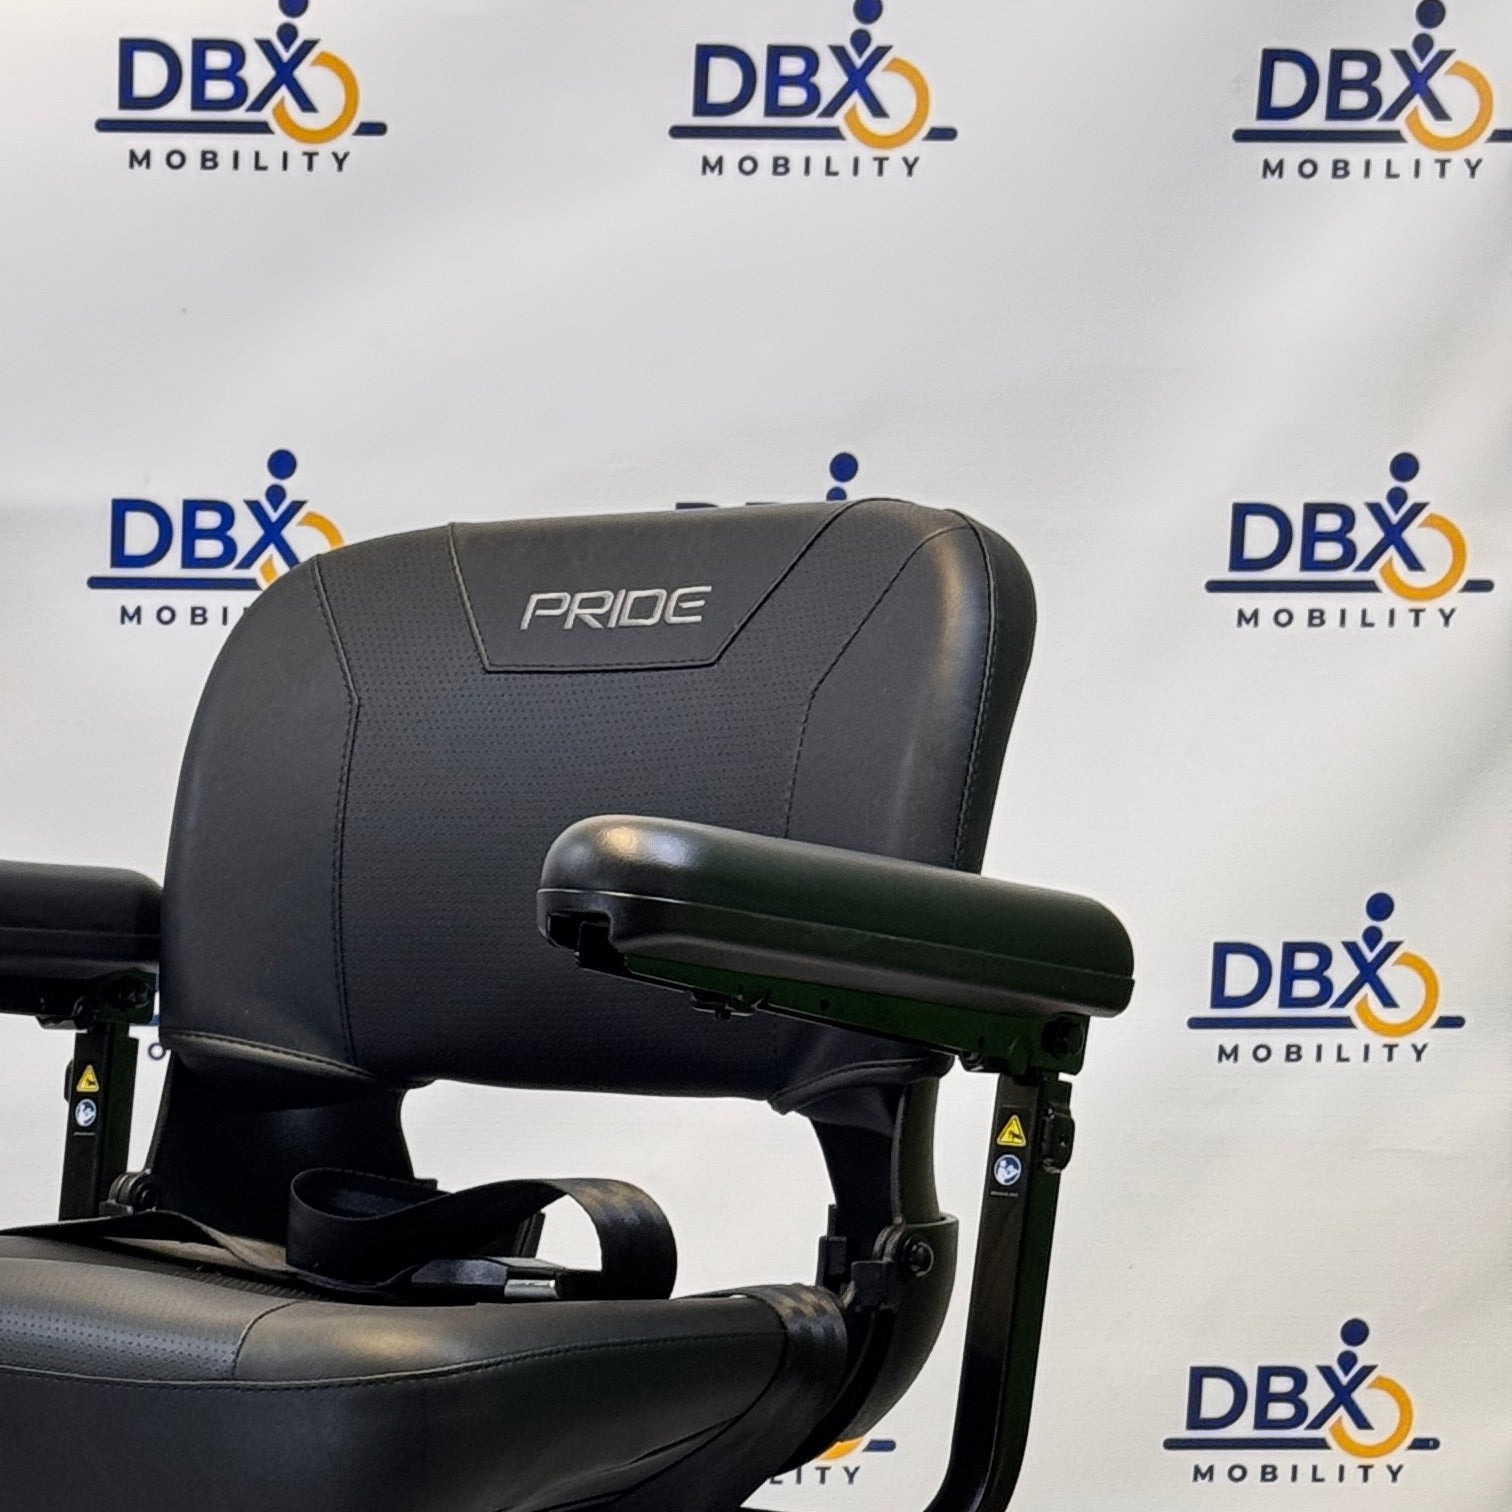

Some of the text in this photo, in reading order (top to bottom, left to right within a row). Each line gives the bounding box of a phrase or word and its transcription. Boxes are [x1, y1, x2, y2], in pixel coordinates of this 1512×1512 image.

[118, 38, 320, 113] DBX
[693, 44, 893, 118] DBX
[1256, 48, 1456, 121] DBX
[129, 149, 350, 172] MOBILITY
[702, 155, 919, 177] MOBILITY
[1262, 158, 1482, 179] MOBILITY
[110, 499, 307, 570] DBX
[1229, 502, 1429, 572] DBX
[120, 605, 228, 626] MOBI
[521, 586, 711, 629] PRIDE
[1237, 608, 1455, 628] MOBILITY
[1210, 941, 1403, 1009] DBX
[1218, 1043, 1427, 1063] MOBILITY
[1186, 1365, 1378, 1430] DBX
[1193, 1464, 1403, 1483] MOBILITY
